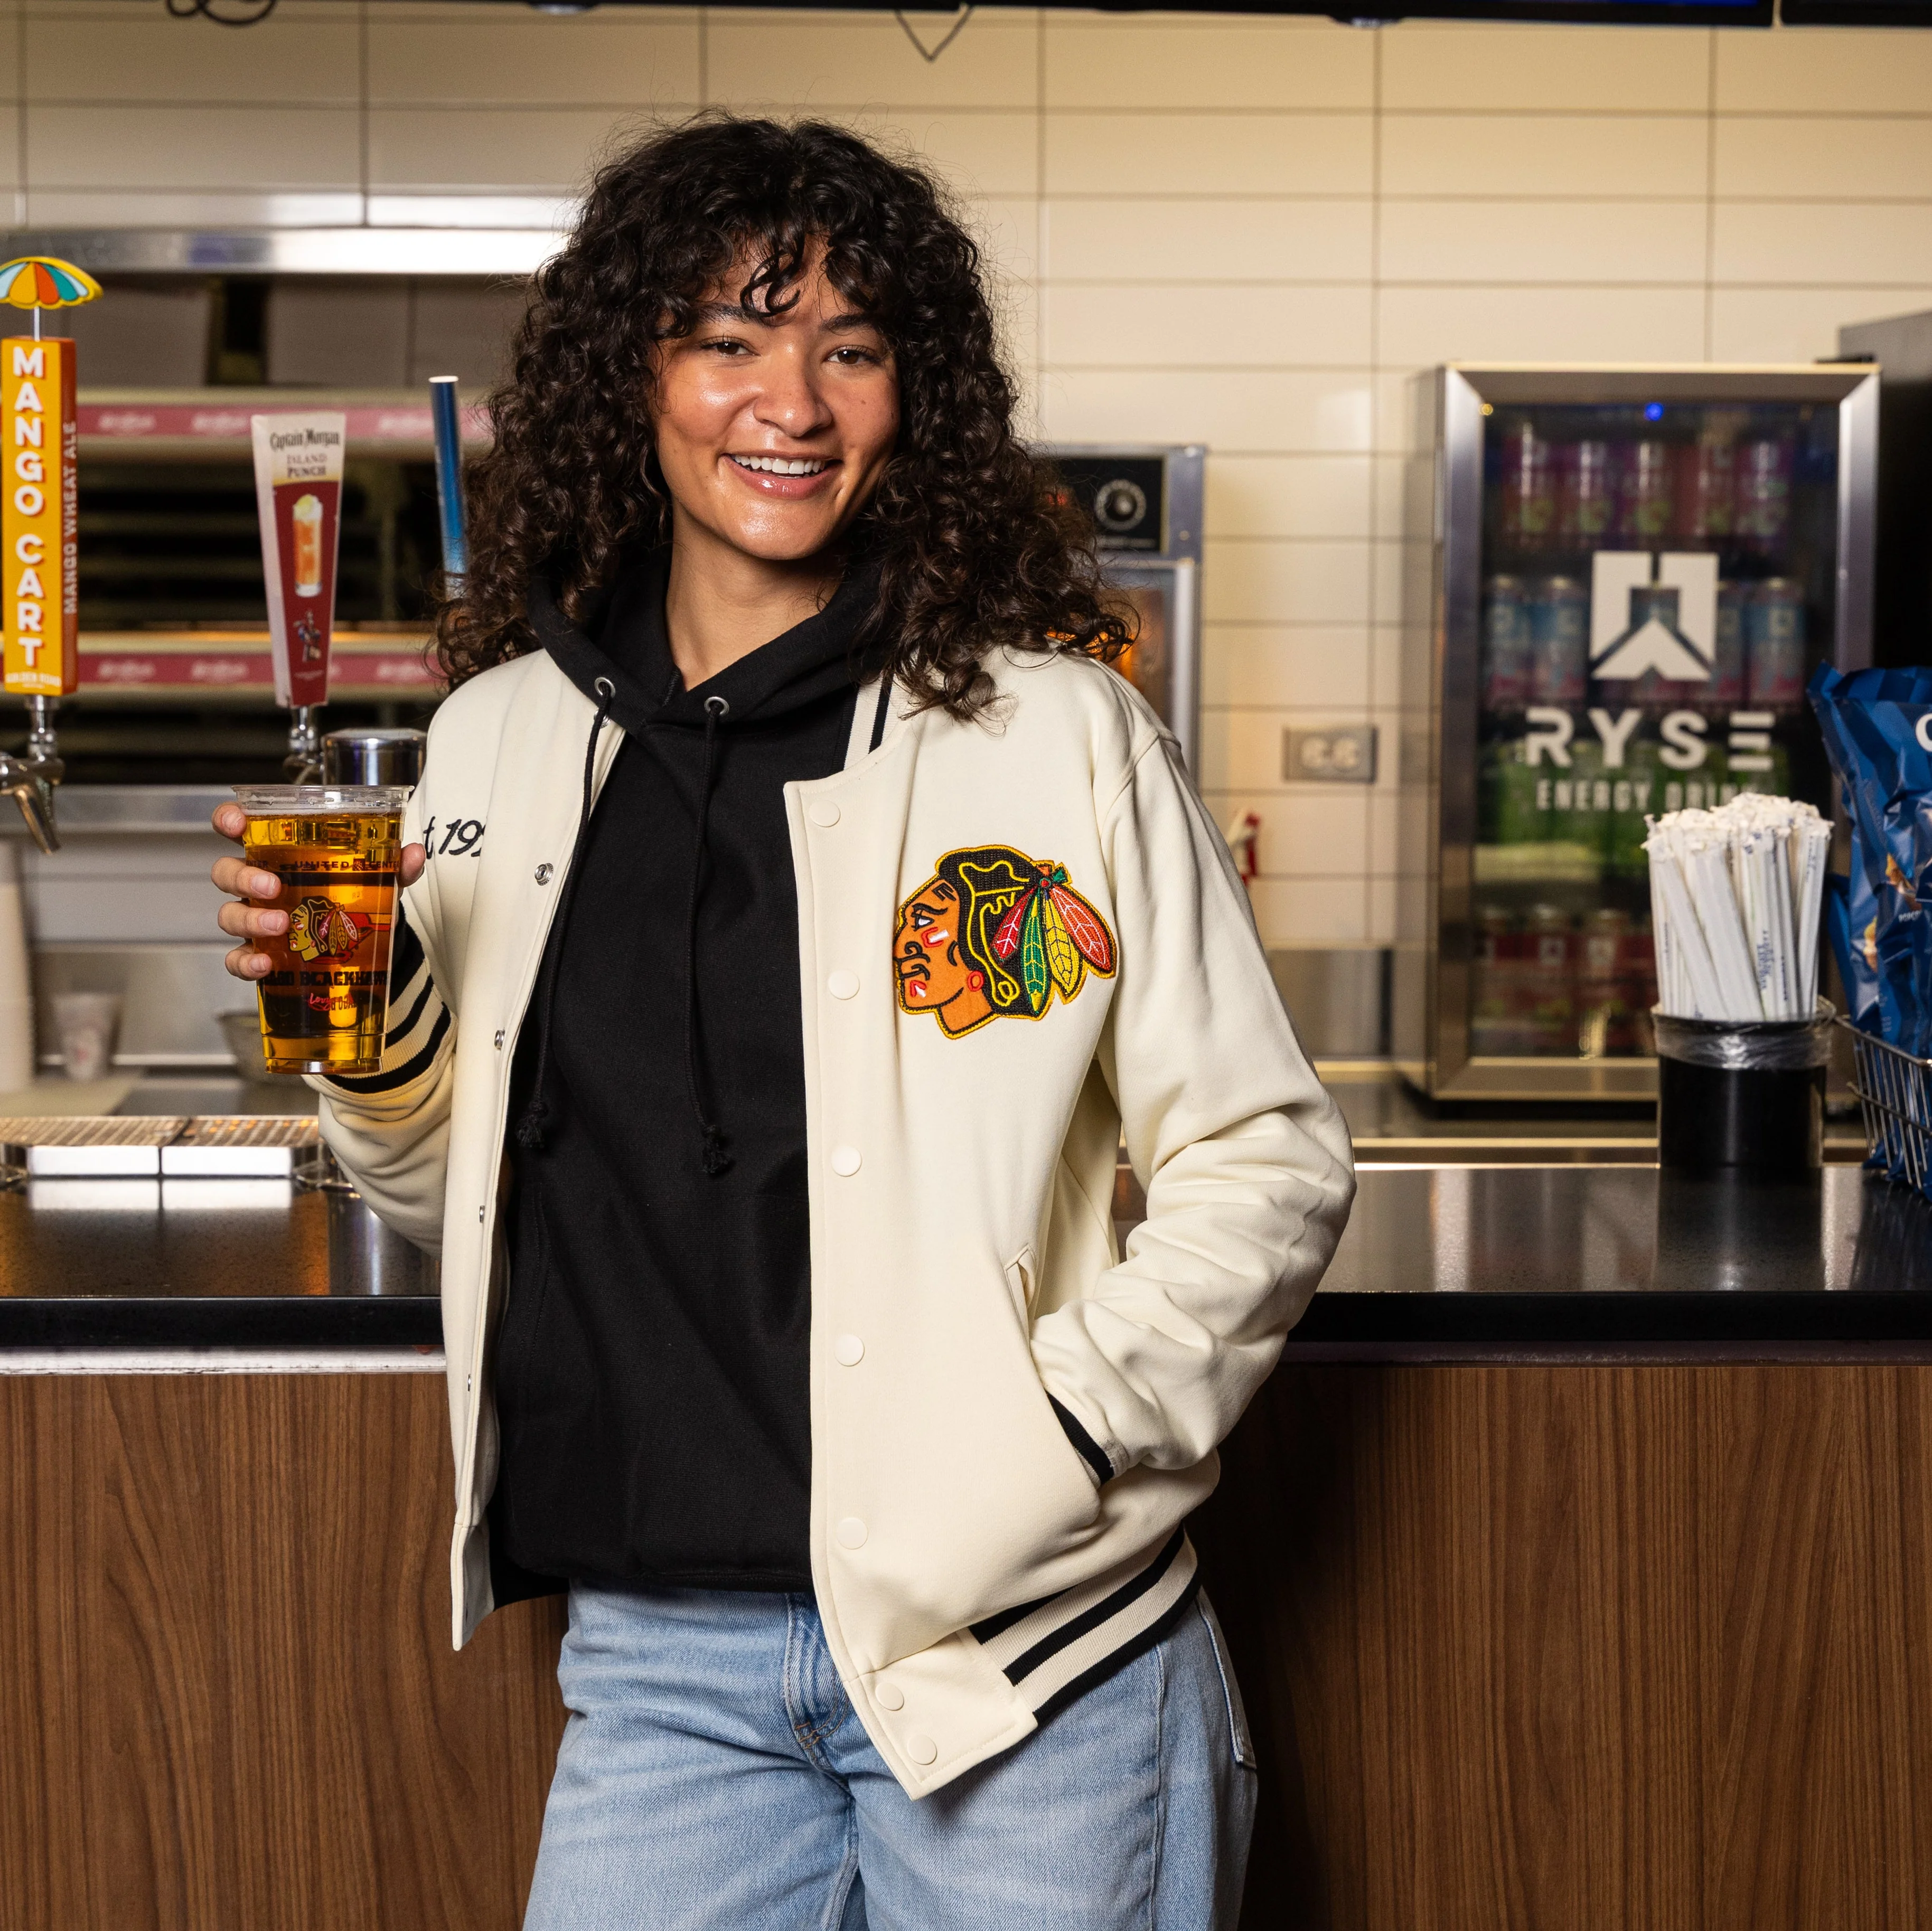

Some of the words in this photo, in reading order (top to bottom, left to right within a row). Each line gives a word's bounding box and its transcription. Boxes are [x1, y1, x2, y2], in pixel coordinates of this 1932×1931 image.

[13, 346, 45, 516] MANGO
[63, 421, 77, 459] ALE
[270, 430, 303, 451] Captain
[304, 428, 340, 449] Morgan
[287, 465, 326, 478] PUNCH
[63, 464, 77, 537] WHEAT
[63, 542, 77, 614] MANGO
[16, 533, 44, 667] CART
[1525, 707, 1775, 771] RYSE
[1536, 778, 1652, 813] ENERGY
[1665, 781, 1758, 811] DRIN
[370, 860, 400, 870] CENTE
[299, 971, 388, 986] BLACKHAW
